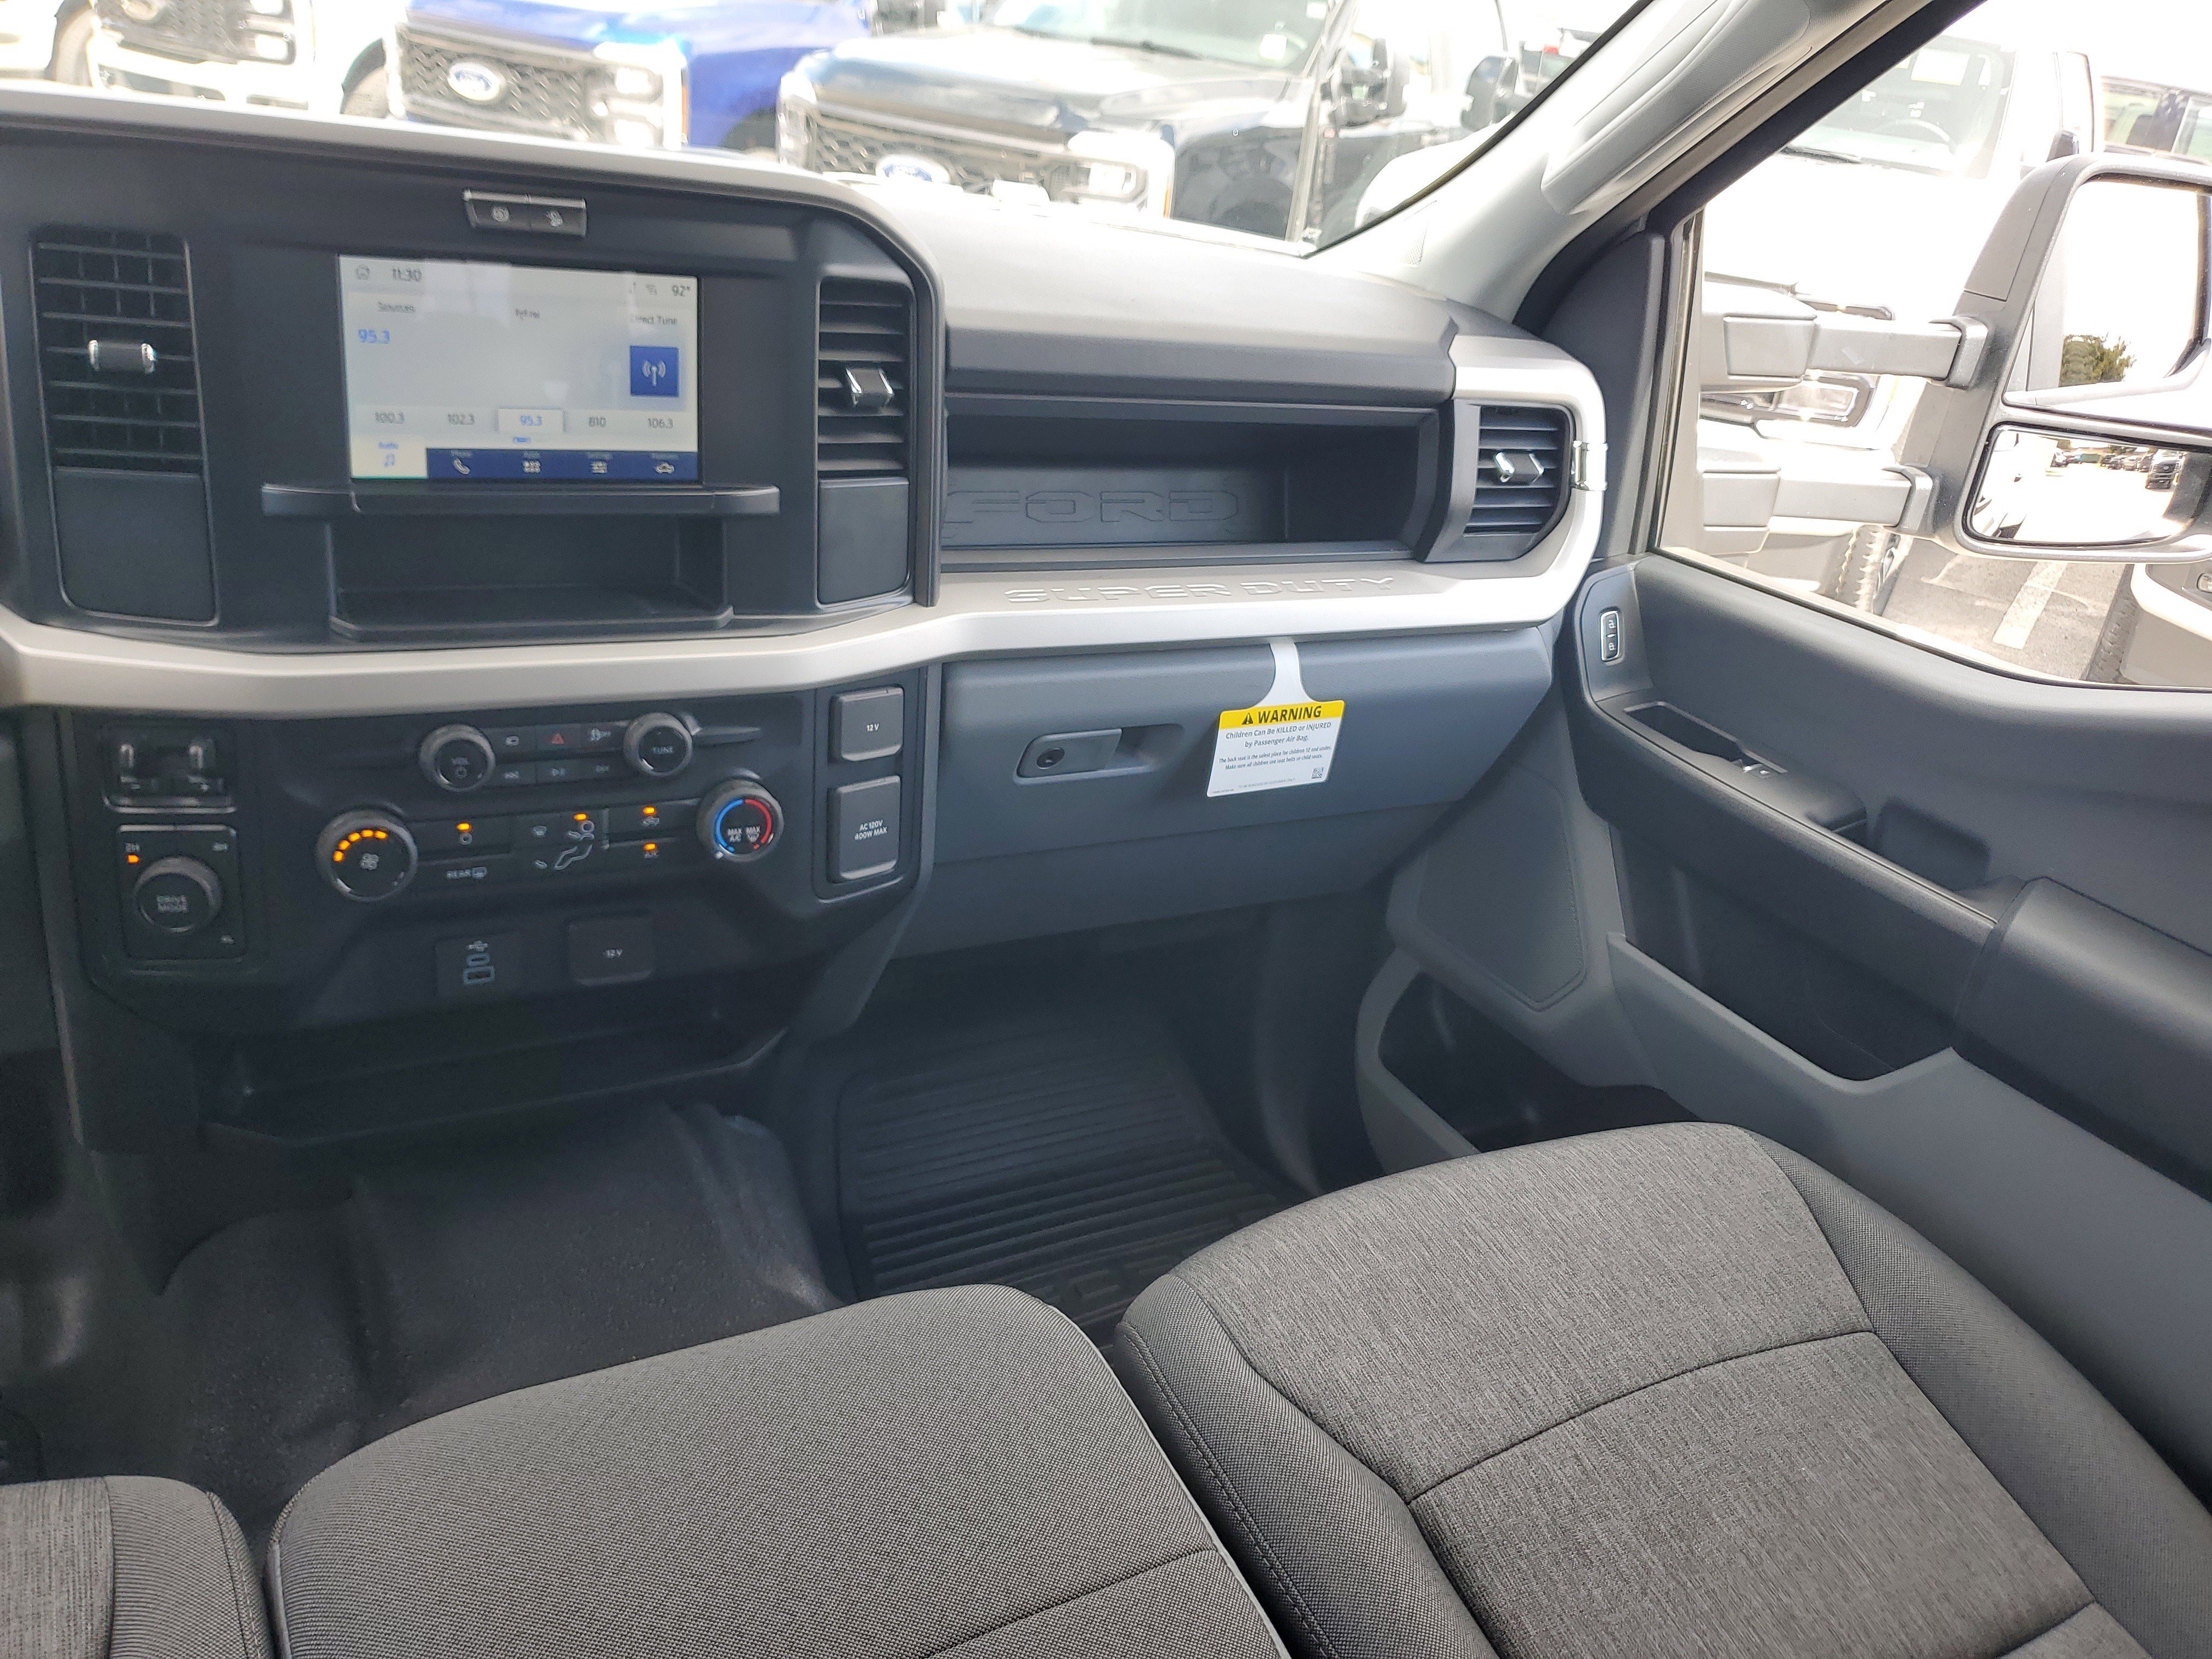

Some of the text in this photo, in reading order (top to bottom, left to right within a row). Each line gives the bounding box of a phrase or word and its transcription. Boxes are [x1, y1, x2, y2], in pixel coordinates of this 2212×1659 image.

[358, 329, 391, 345] 95.3
[943, 489, 1239, 524] FORD
[1003, 577, 1395, 603] SUPER DUTY
[1258, 705, 1322, 724] WARNING
[1226, 731, 1252, 740] Children
[1276, 725, 1297, 734] KILLED
[1306, 721, 1331, 731] INJURED
[1254, 737, 1285, 746] Passenger
[727, 827, 742, 836] MAX
[746, 825, 760, 834] MAX
[859, 820, 883, 831] AC 120V
[873, 826, 888, 836] MAX
